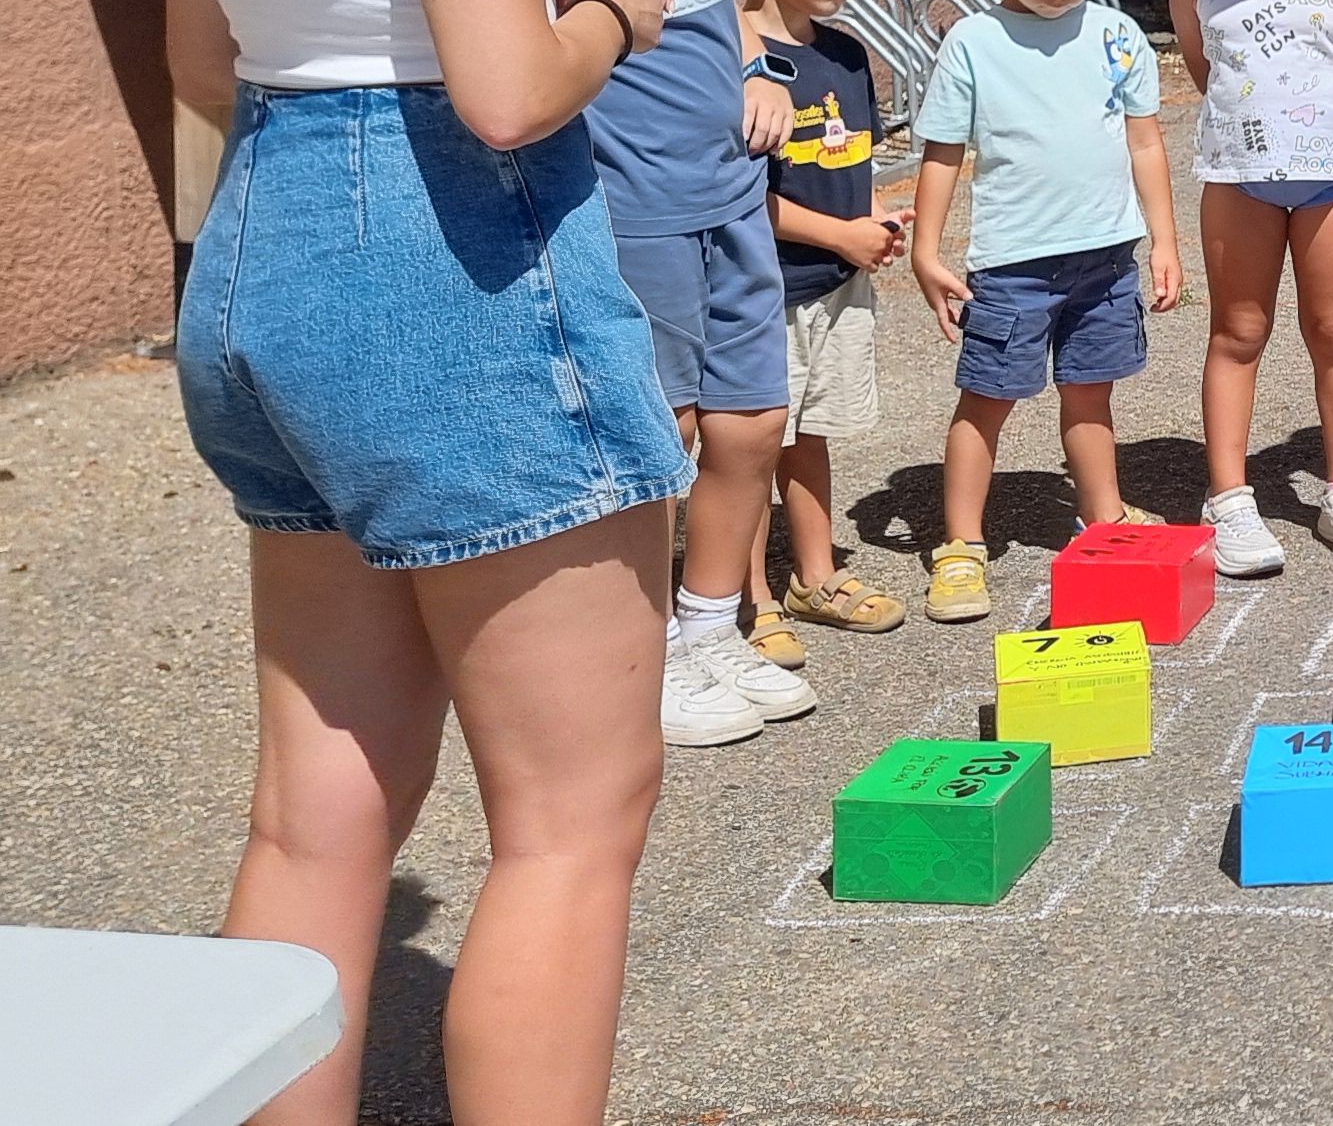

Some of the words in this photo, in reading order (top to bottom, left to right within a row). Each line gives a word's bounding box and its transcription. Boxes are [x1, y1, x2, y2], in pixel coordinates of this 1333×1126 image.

[1241, 1, 1287, 33] DAYS
[1254, 22, 1277, 43] OF
[1260, 30, 1296, 59] FUN
[1021, 637, 1060, 653] 7
[1284, 730, 1333, 755] 14
[958, 750, 1021, 776] 13
[1277, 760, 1333, 769] VIDA
